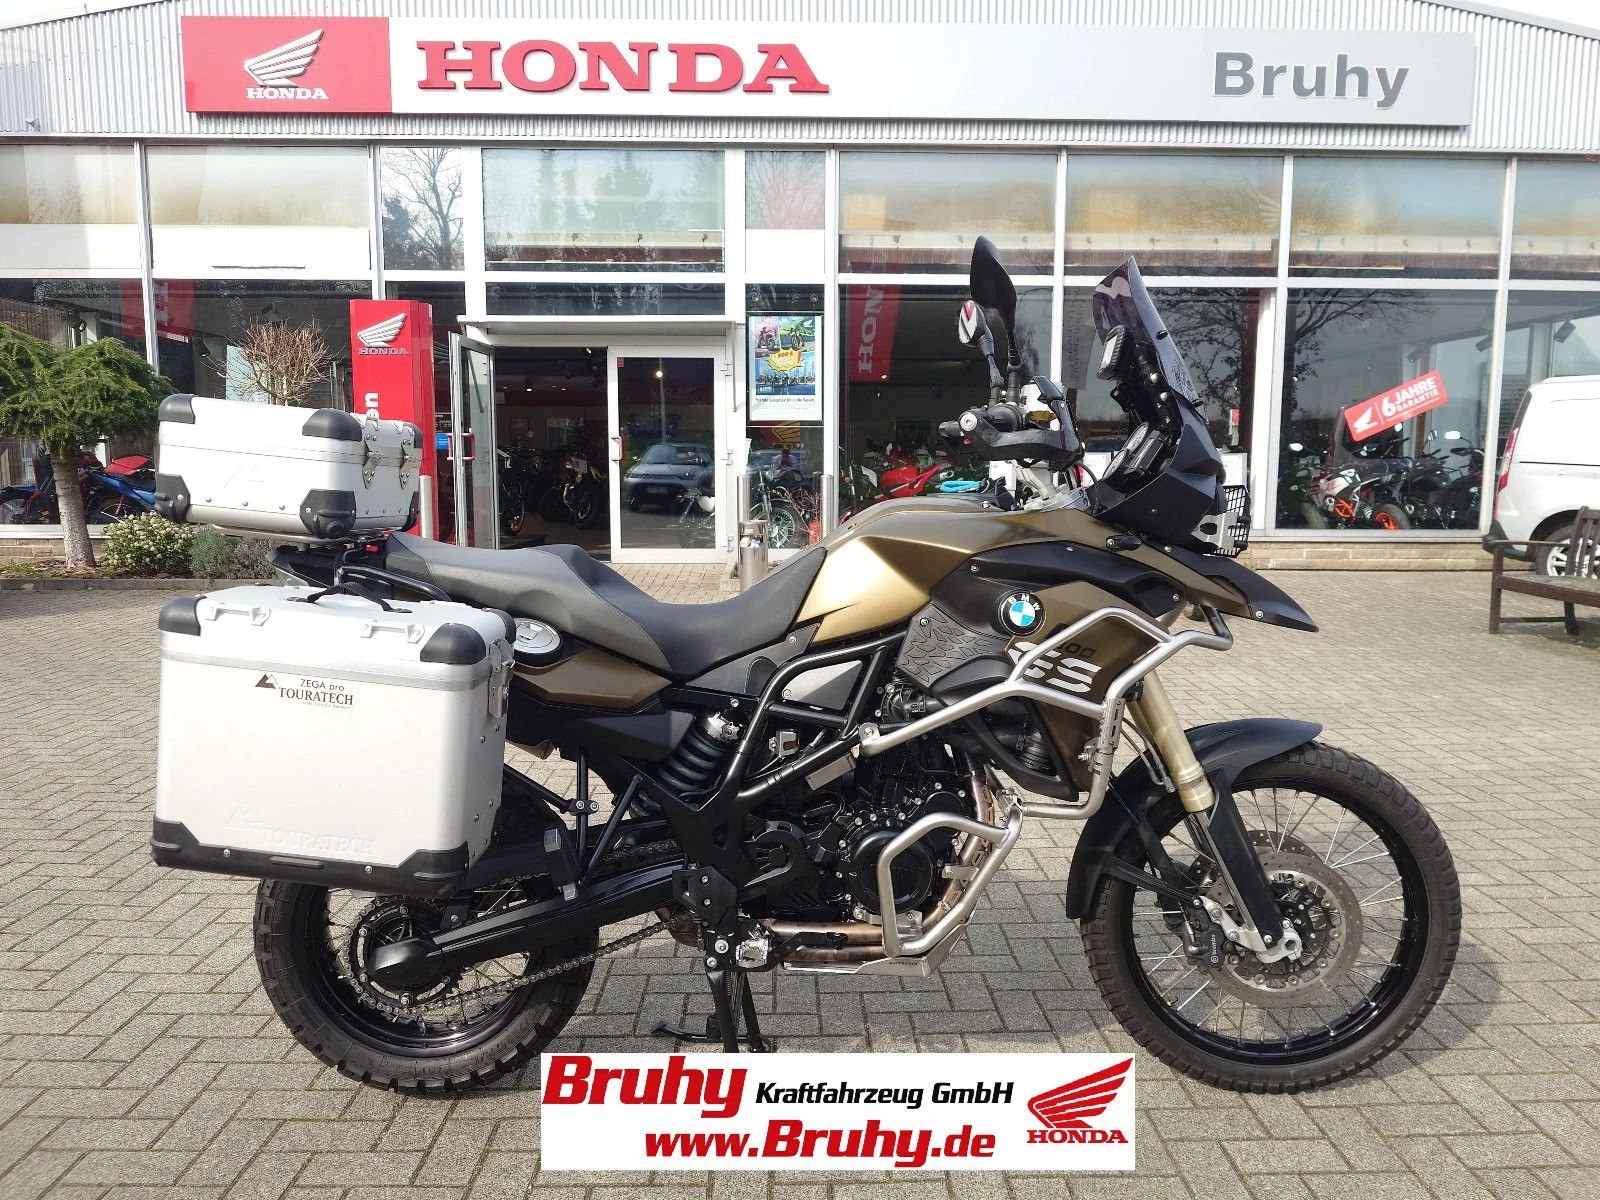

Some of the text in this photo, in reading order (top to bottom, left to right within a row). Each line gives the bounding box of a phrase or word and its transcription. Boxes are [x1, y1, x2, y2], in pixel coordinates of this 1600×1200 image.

[416, 39, 829, 93] HONDA
[1213, 51, 1410, 109] Bruhy
[246, 87, 330, 100] HONDA
[358, 347, 410, 355] HONDA
[1381, 376, 1438, 417] 6 JAHRE
[1396, 388, 1441, 412] GARANTIE
[1008, 593, 1041, 611] BMW
[300, 678, 345, 692] ZEGA pro
[279, 687, 354, 706] TOURATECH
